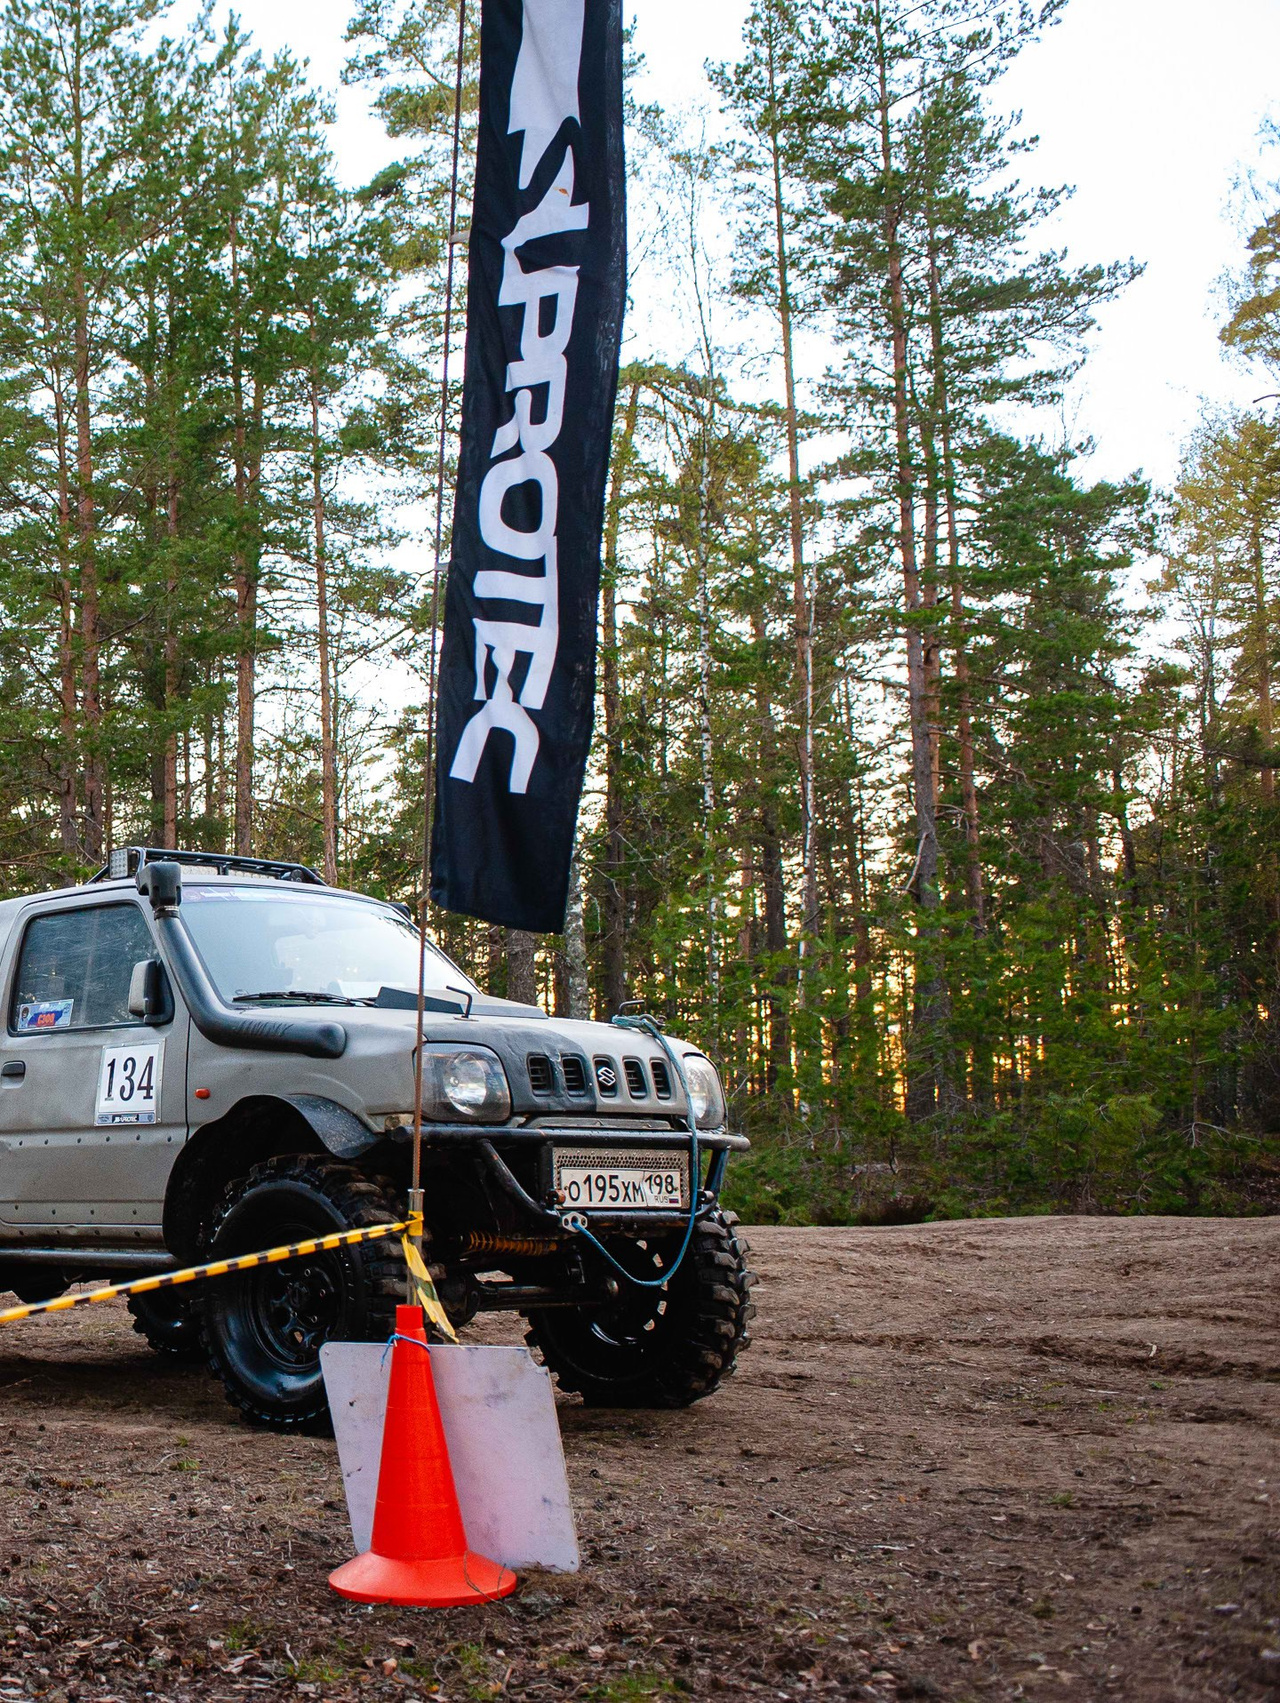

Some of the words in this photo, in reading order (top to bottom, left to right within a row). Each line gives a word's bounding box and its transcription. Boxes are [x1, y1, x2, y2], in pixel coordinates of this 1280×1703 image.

[449, 115, 588, 796] SUPROTEC
[104, 1055, 154, 1102] 134
[644, 1173, 674, 1195] 198
[654, 1195, 669, 1203] RUS
